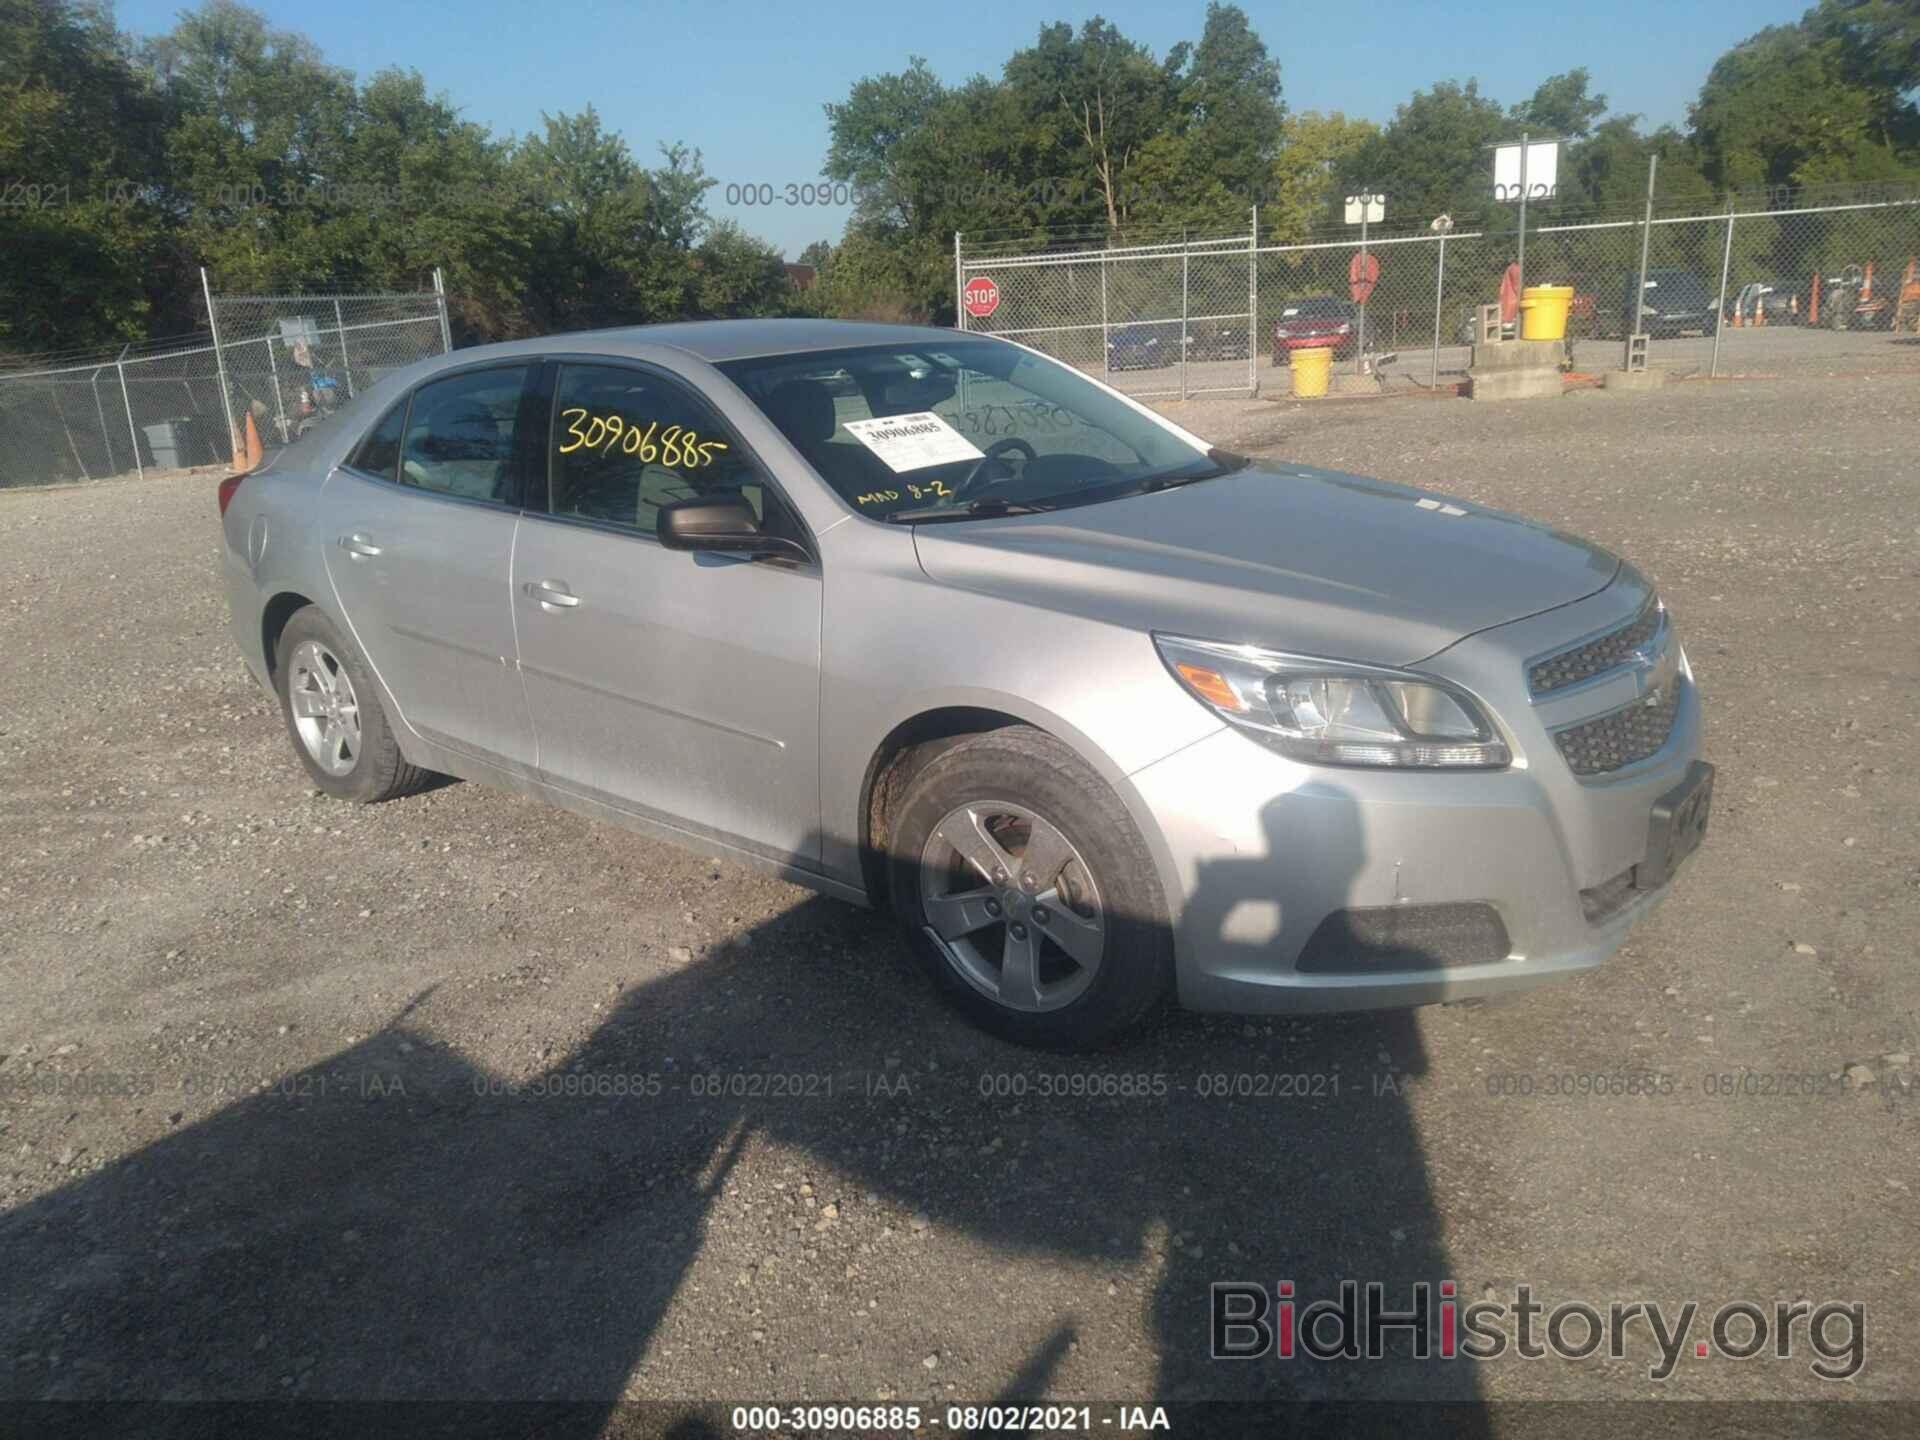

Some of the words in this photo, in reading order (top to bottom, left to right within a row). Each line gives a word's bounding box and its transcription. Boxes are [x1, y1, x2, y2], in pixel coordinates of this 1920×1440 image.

[965, 288, 996, 305] STOP
[559, 408, 728, 468] 30906885
[866, 422, 942, 443] 30906885
[907, 480, 952, 500] 8-2
